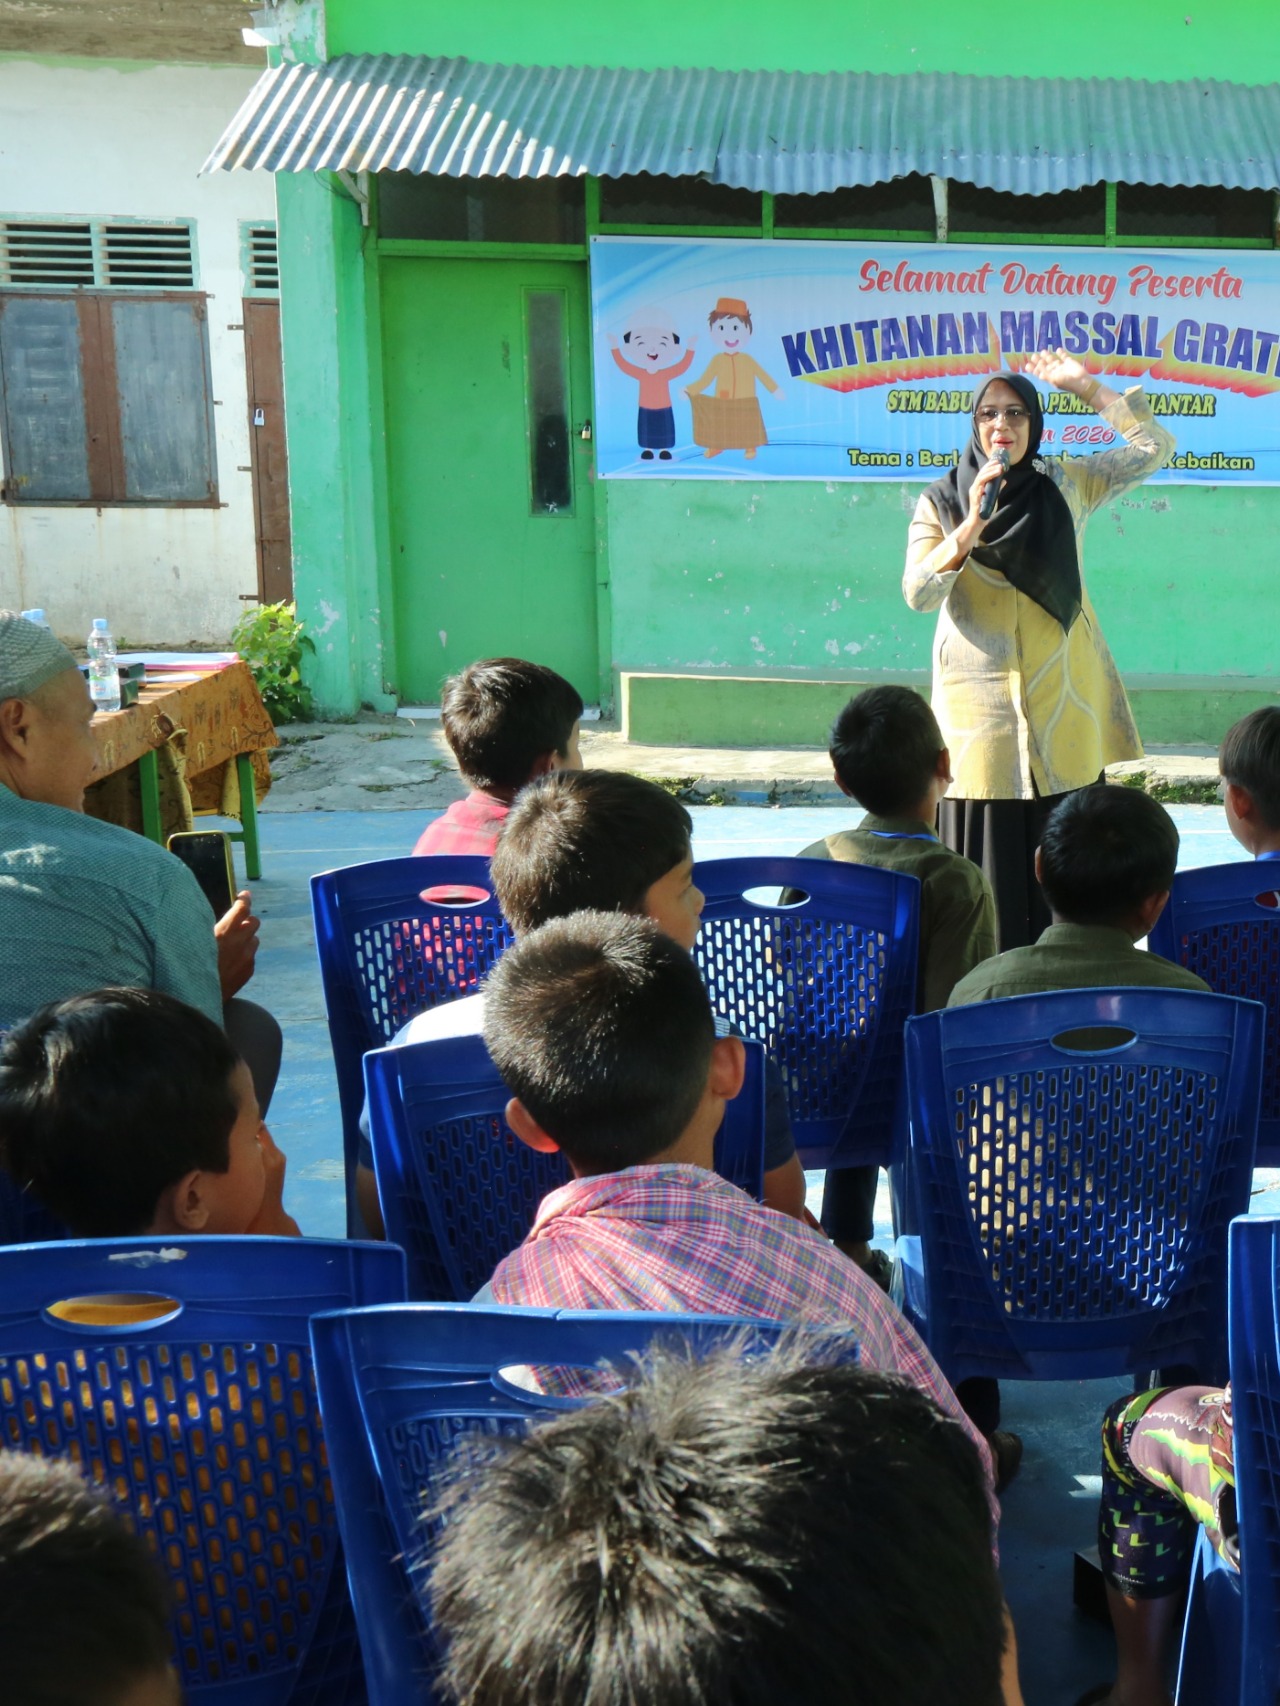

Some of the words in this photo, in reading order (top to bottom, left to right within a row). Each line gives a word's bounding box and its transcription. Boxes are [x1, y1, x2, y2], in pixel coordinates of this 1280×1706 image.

[858, 259, 995, 294] Selamat
[1000, 262, 1117, 305] Datang
[1128, 265, 1244, 299] Peserta
[781, 311, 990, 378] KHITANAN
[1000, 310, 1163, 358] MASSAL
[887, 390, 924, 413] STM
[1061, 425, 1116, 444] 2026
[848, 448, 900, 466] Tema
